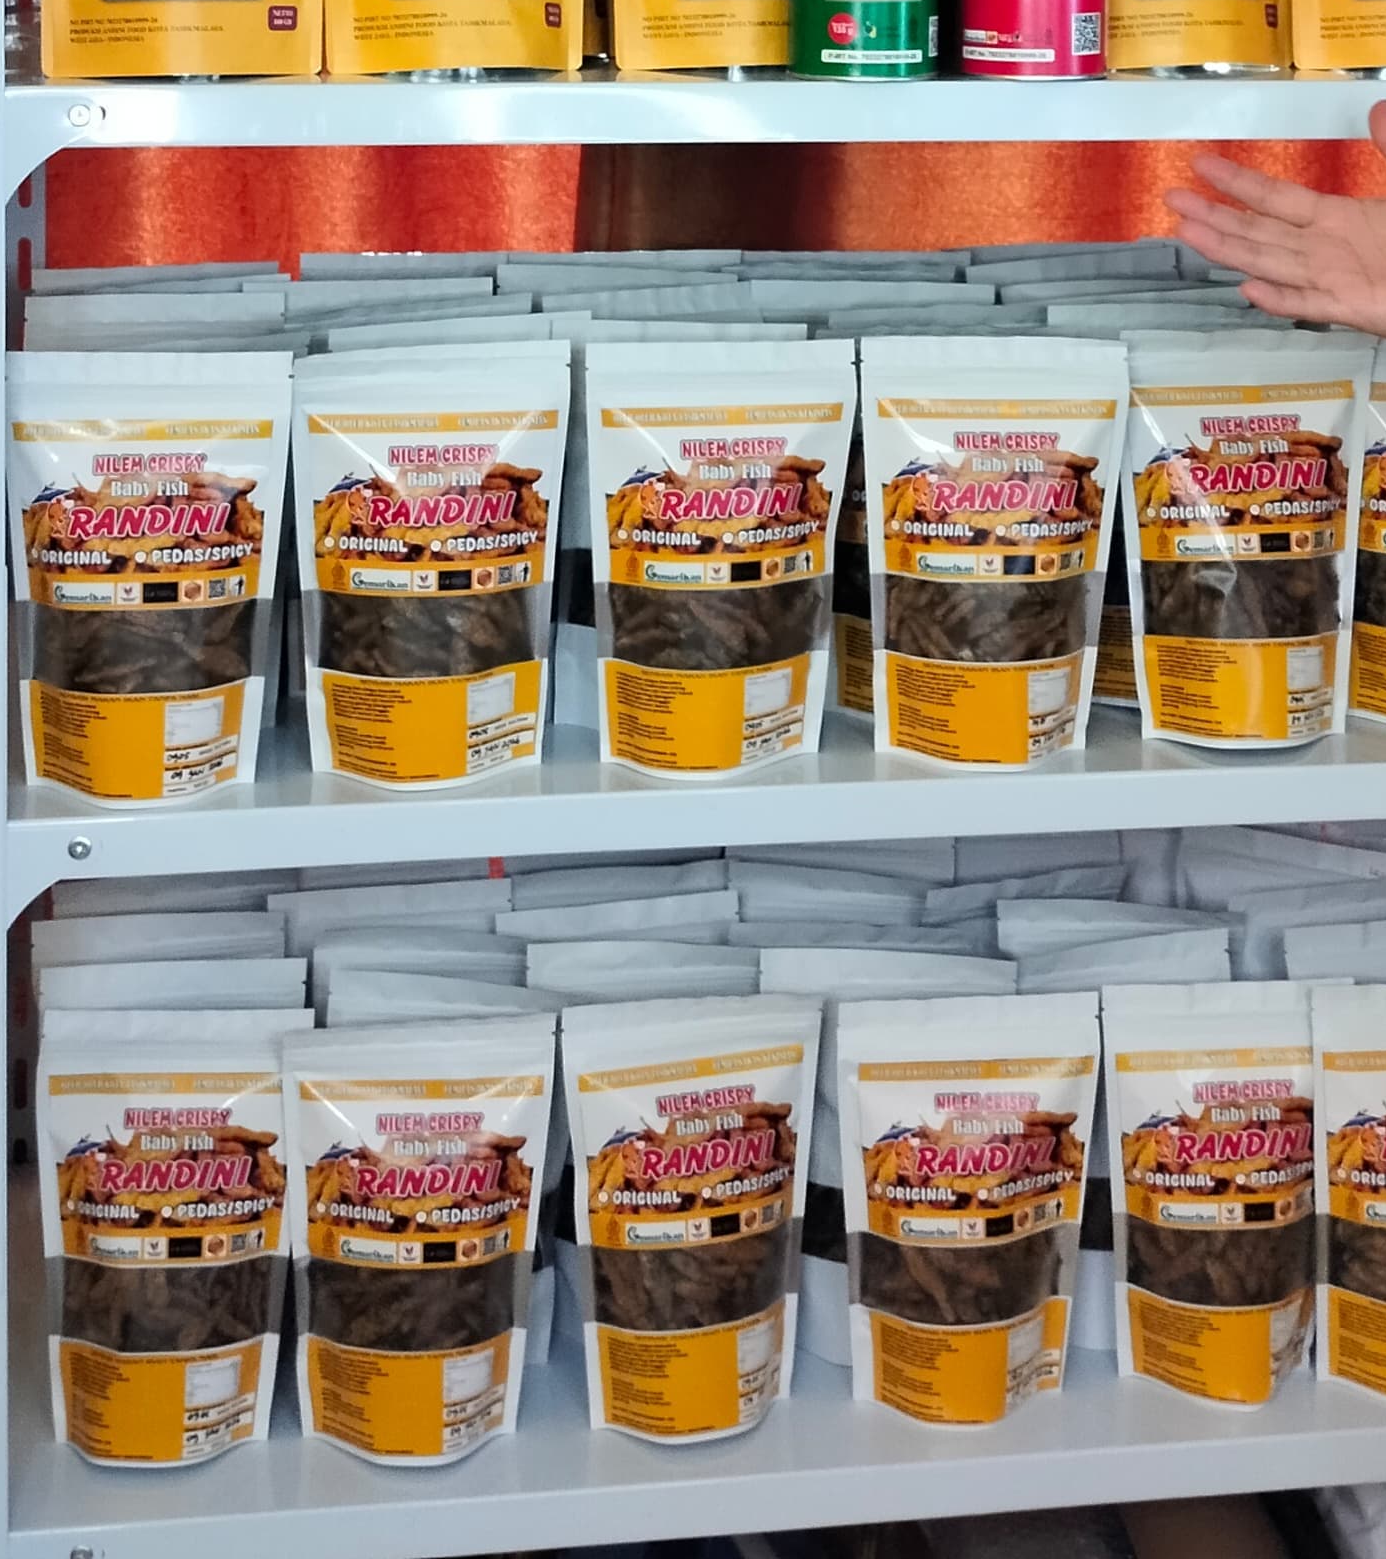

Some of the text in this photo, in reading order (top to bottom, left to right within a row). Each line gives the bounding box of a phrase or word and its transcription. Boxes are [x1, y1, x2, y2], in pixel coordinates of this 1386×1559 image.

[93, 453, 208, 476] NILEM CRISPY
[1188, 459, 1325, 493] RANDINI
[110, 478, 189, 498] Baby Fish
[659, 483, 801, 519] RANDINI
[932, 480, 1078, 512] RANDINI
[68, 502, 230, 539] RANDINI
[368, 491, 516, 527] RANDINI
[41, 542, 254, 566] ORIGINAL PEDAS/SPICY
[640, 1131, 775, 1179] RANDINI
[915, 1137, 1056, 1176] RANDINI
[101, 1156, 252, 1193] RANDINI
[356, 1160, 501, 1198] RANDINI
[1146, 1173, 1215, 1187] ORIGINAL
